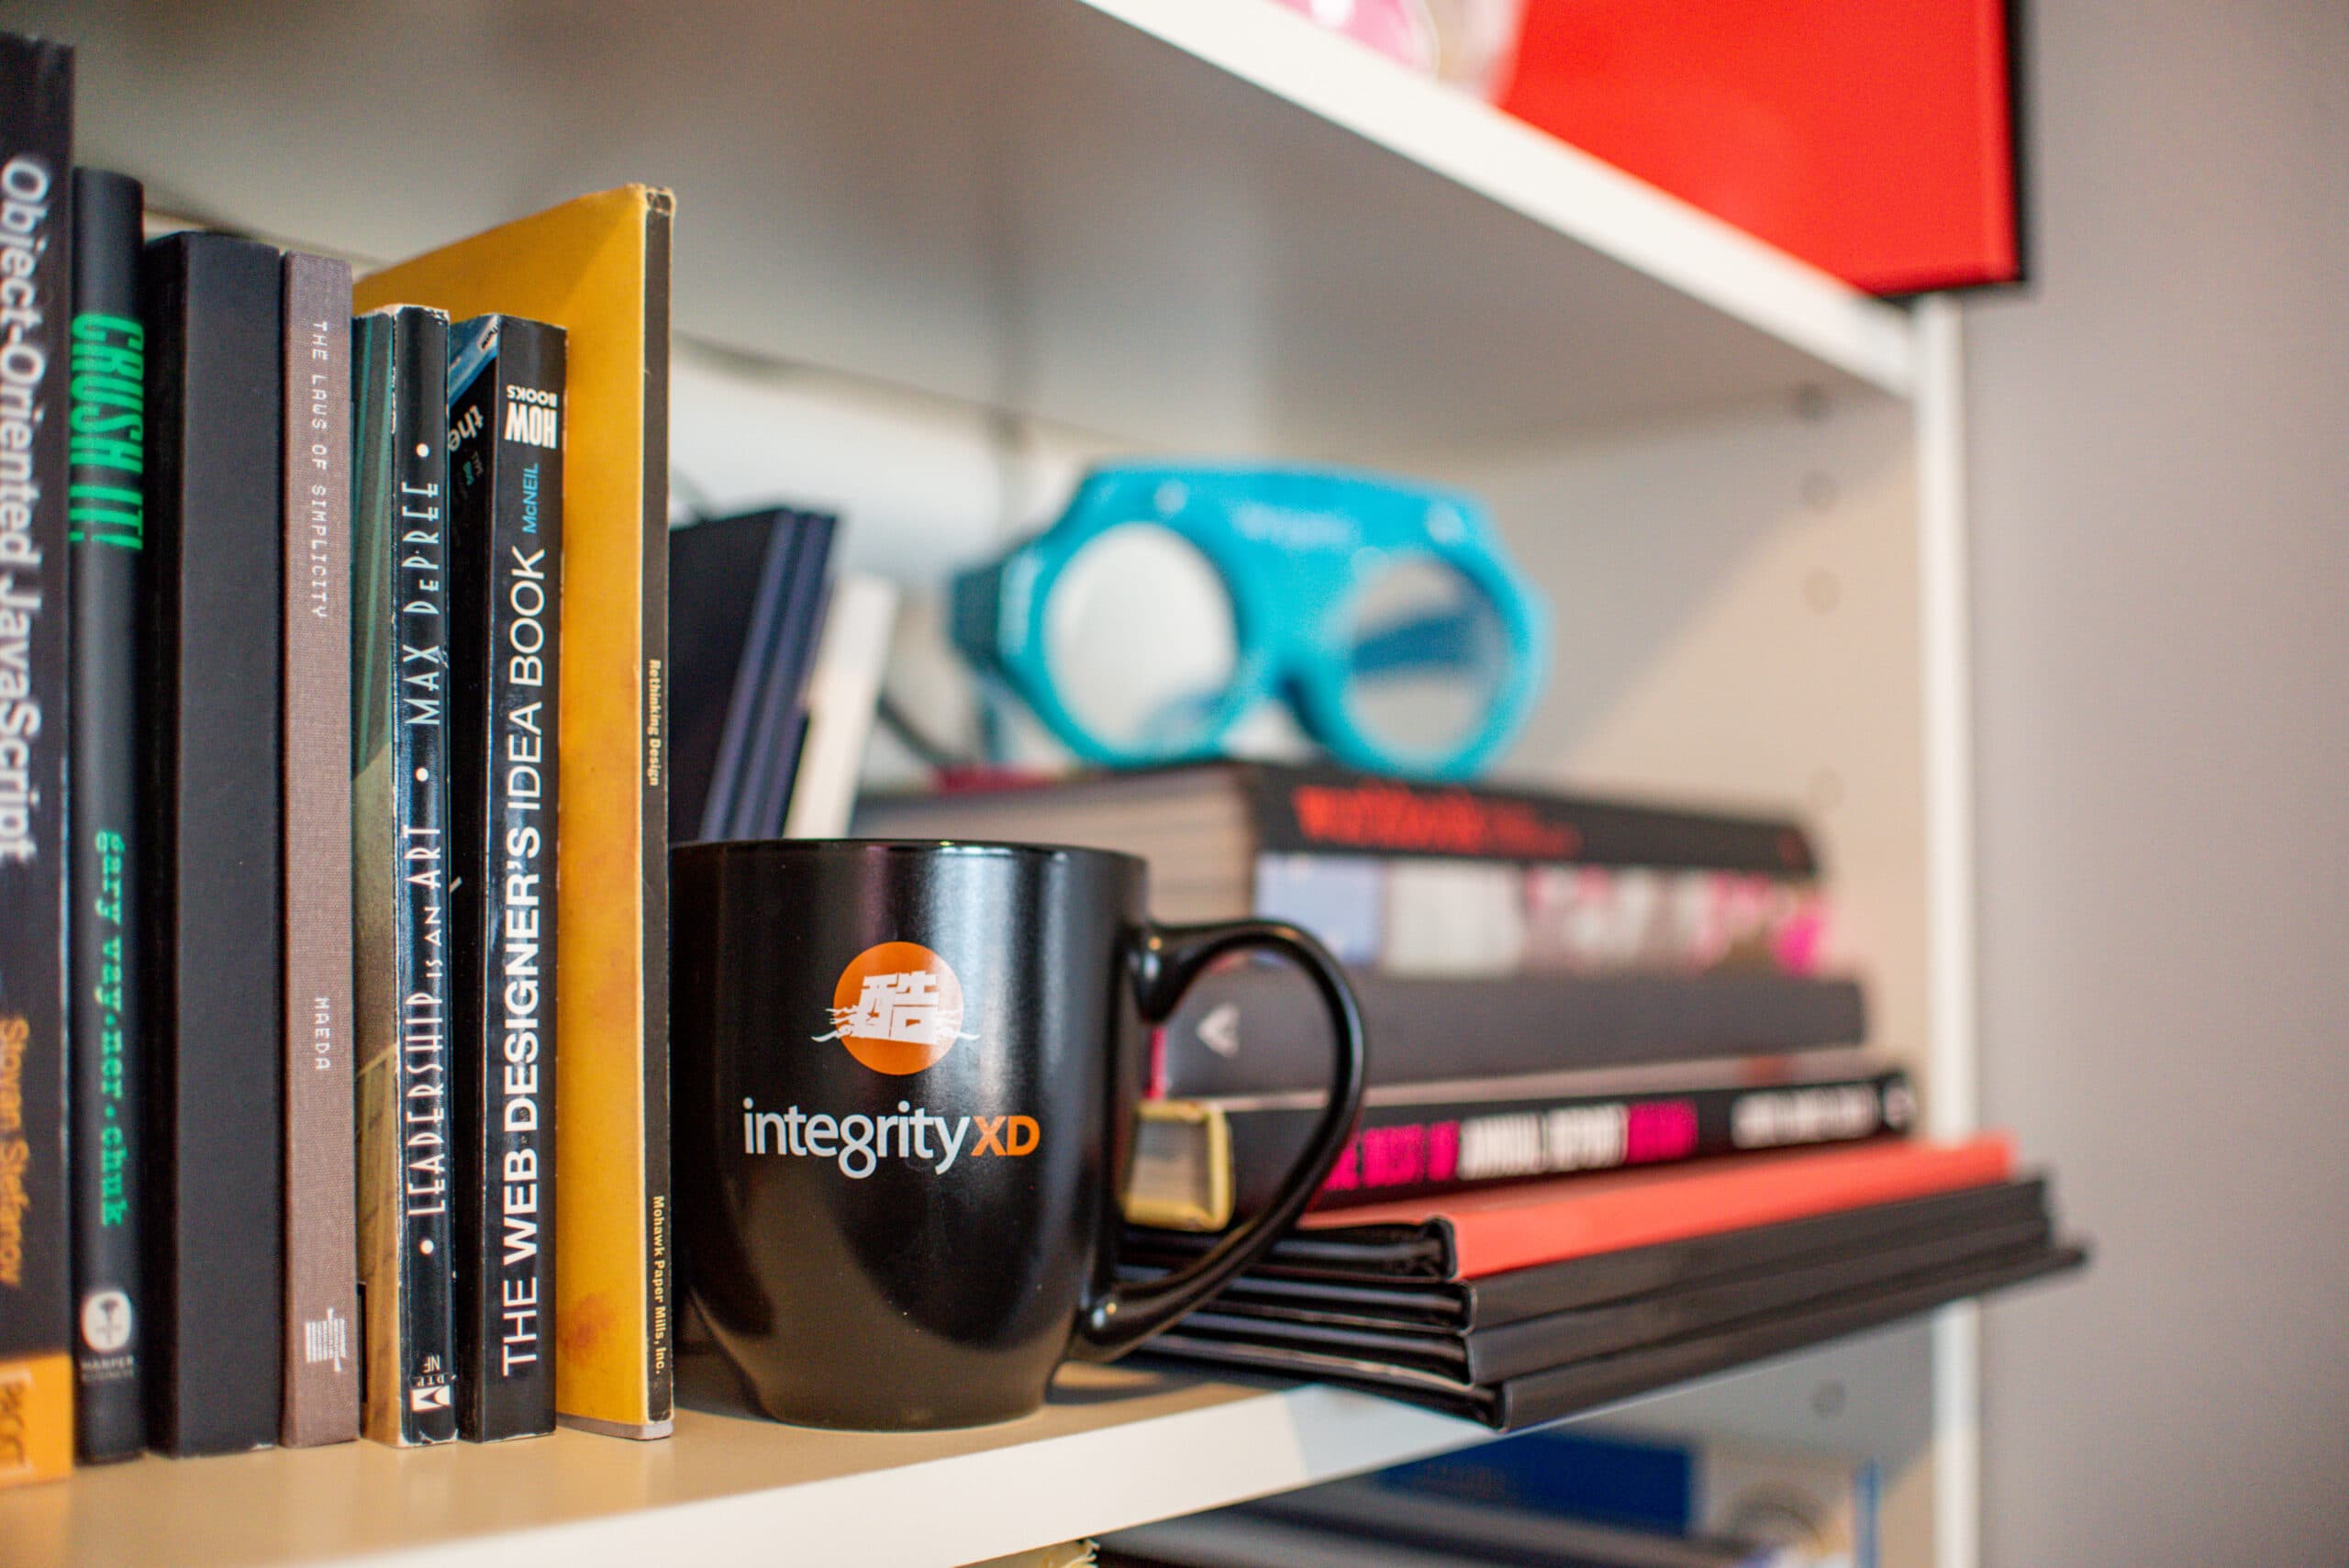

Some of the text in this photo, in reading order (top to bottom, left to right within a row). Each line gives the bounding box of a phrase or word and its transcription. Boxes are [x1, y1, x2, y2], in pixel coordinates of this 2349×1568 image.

[69, 313, 144, 550] CRUSH IT!
[505, 401, 558, 450] HOW
[506, 384, 559, 408] BOOKS
[0, 161, 49, 864] Object-Oriented JavaScript
[311, 322, 328, 620] THE LAWS OF SIMPLICITY
[522, 462, 540, 534] McNEIL
[404, 644, 441, 726] MAX
[647, 659, 662, 786] Rethinking Design
[95, 831, 126, 926] gary
[404, 824, 441, 890] ART
[424, 905, 442, 948] AN
[425, 957, 443, 979] IS
[502, 545, 547, 1376] THE WEB DESIGNER'S IDEA BOOK
[315, 997, 330, 1071] MAEDA
[405, 991, 446, 1217] LEADERSHIP
[651, 1195, 667, 1374] Mohawk Paper Mills, Inc.
